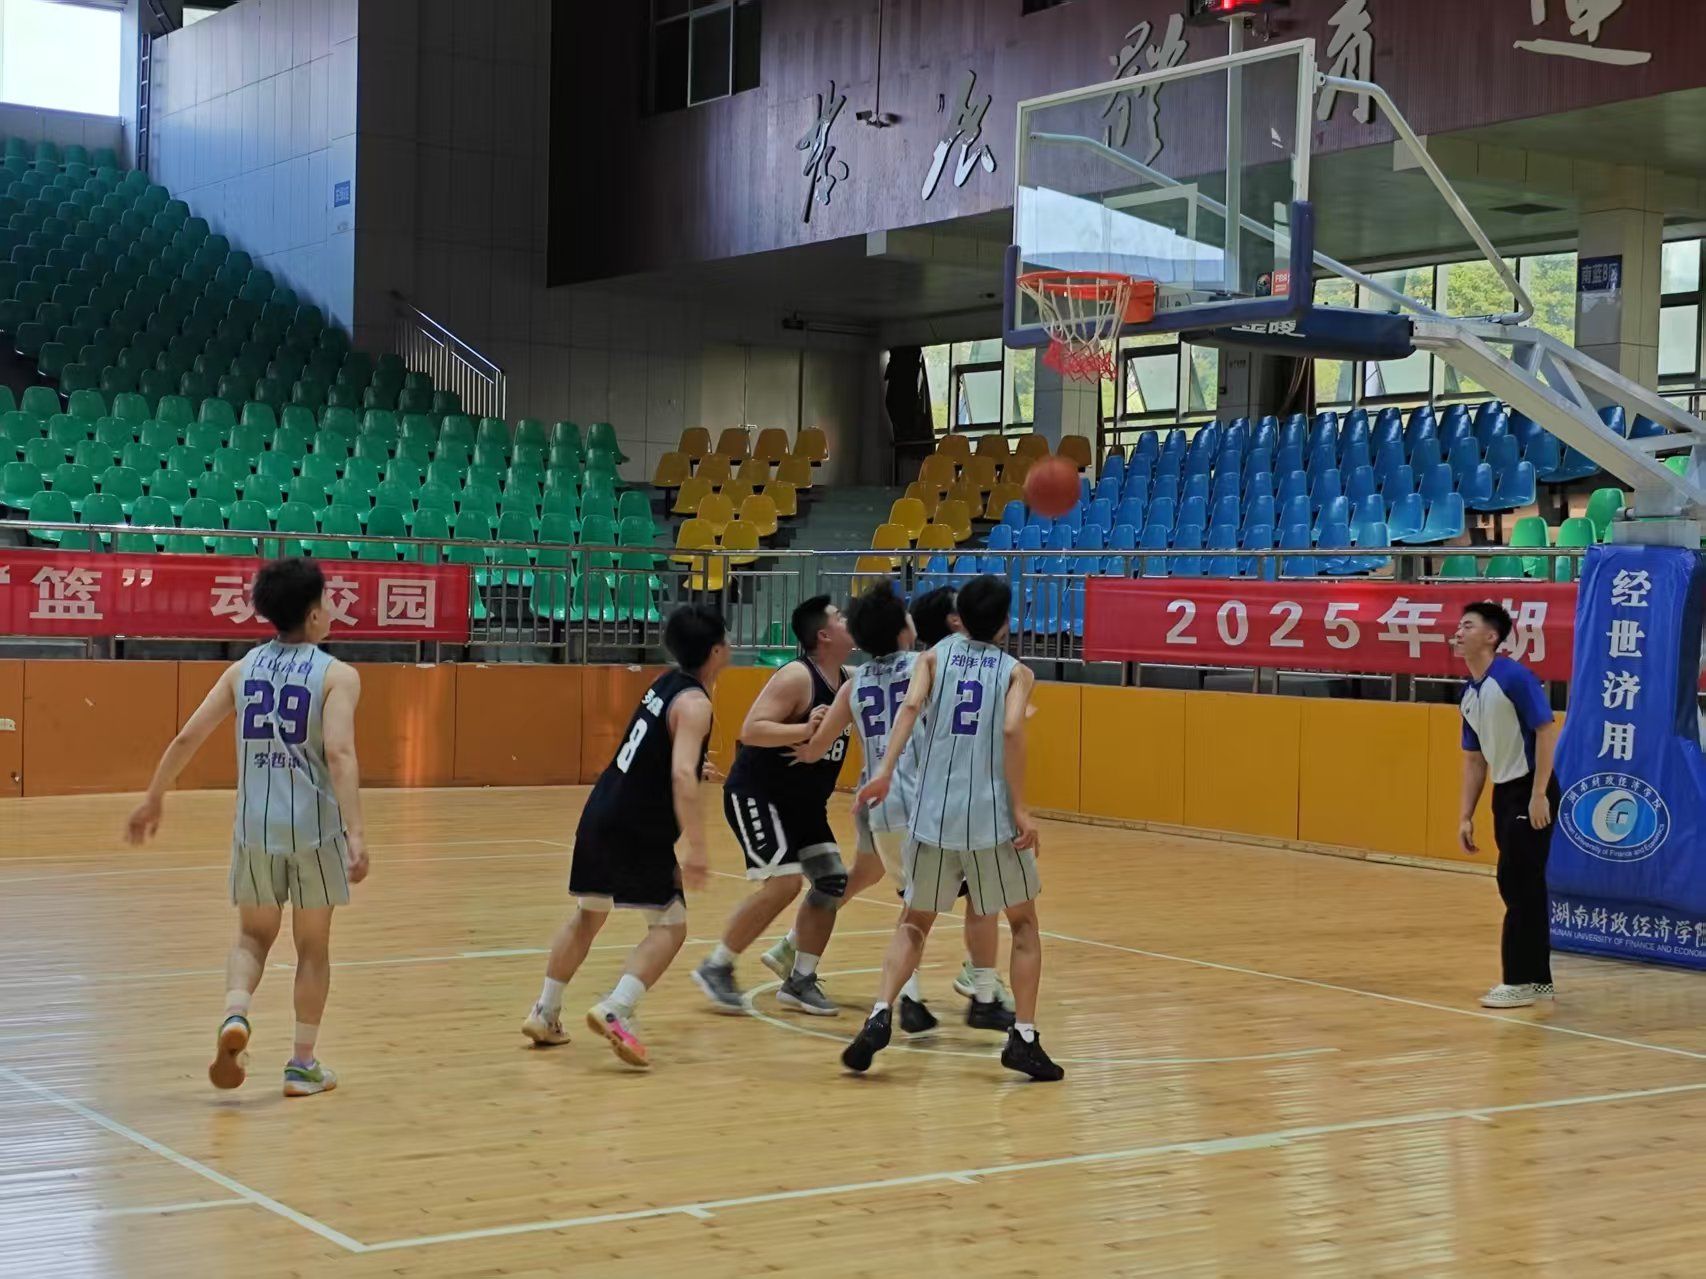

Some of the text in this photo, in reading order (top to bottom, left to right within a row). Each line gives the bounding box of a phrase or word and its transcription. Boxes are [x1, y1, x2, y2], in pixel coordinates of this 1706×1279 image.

[1597, 568, 1651, 761] 经世济用
[243, 679, 312, 744] 29
[951, 680, 983, 735] 2
[616, 717, 648, 774] 8
[1550, 928, 1572, 938] HUNAN
[1574, 931, 1612, 945] UNIVERSITY
[1625, 940, 1656, 951] FINANCE
[1657, 944, 1673, 953] AND
